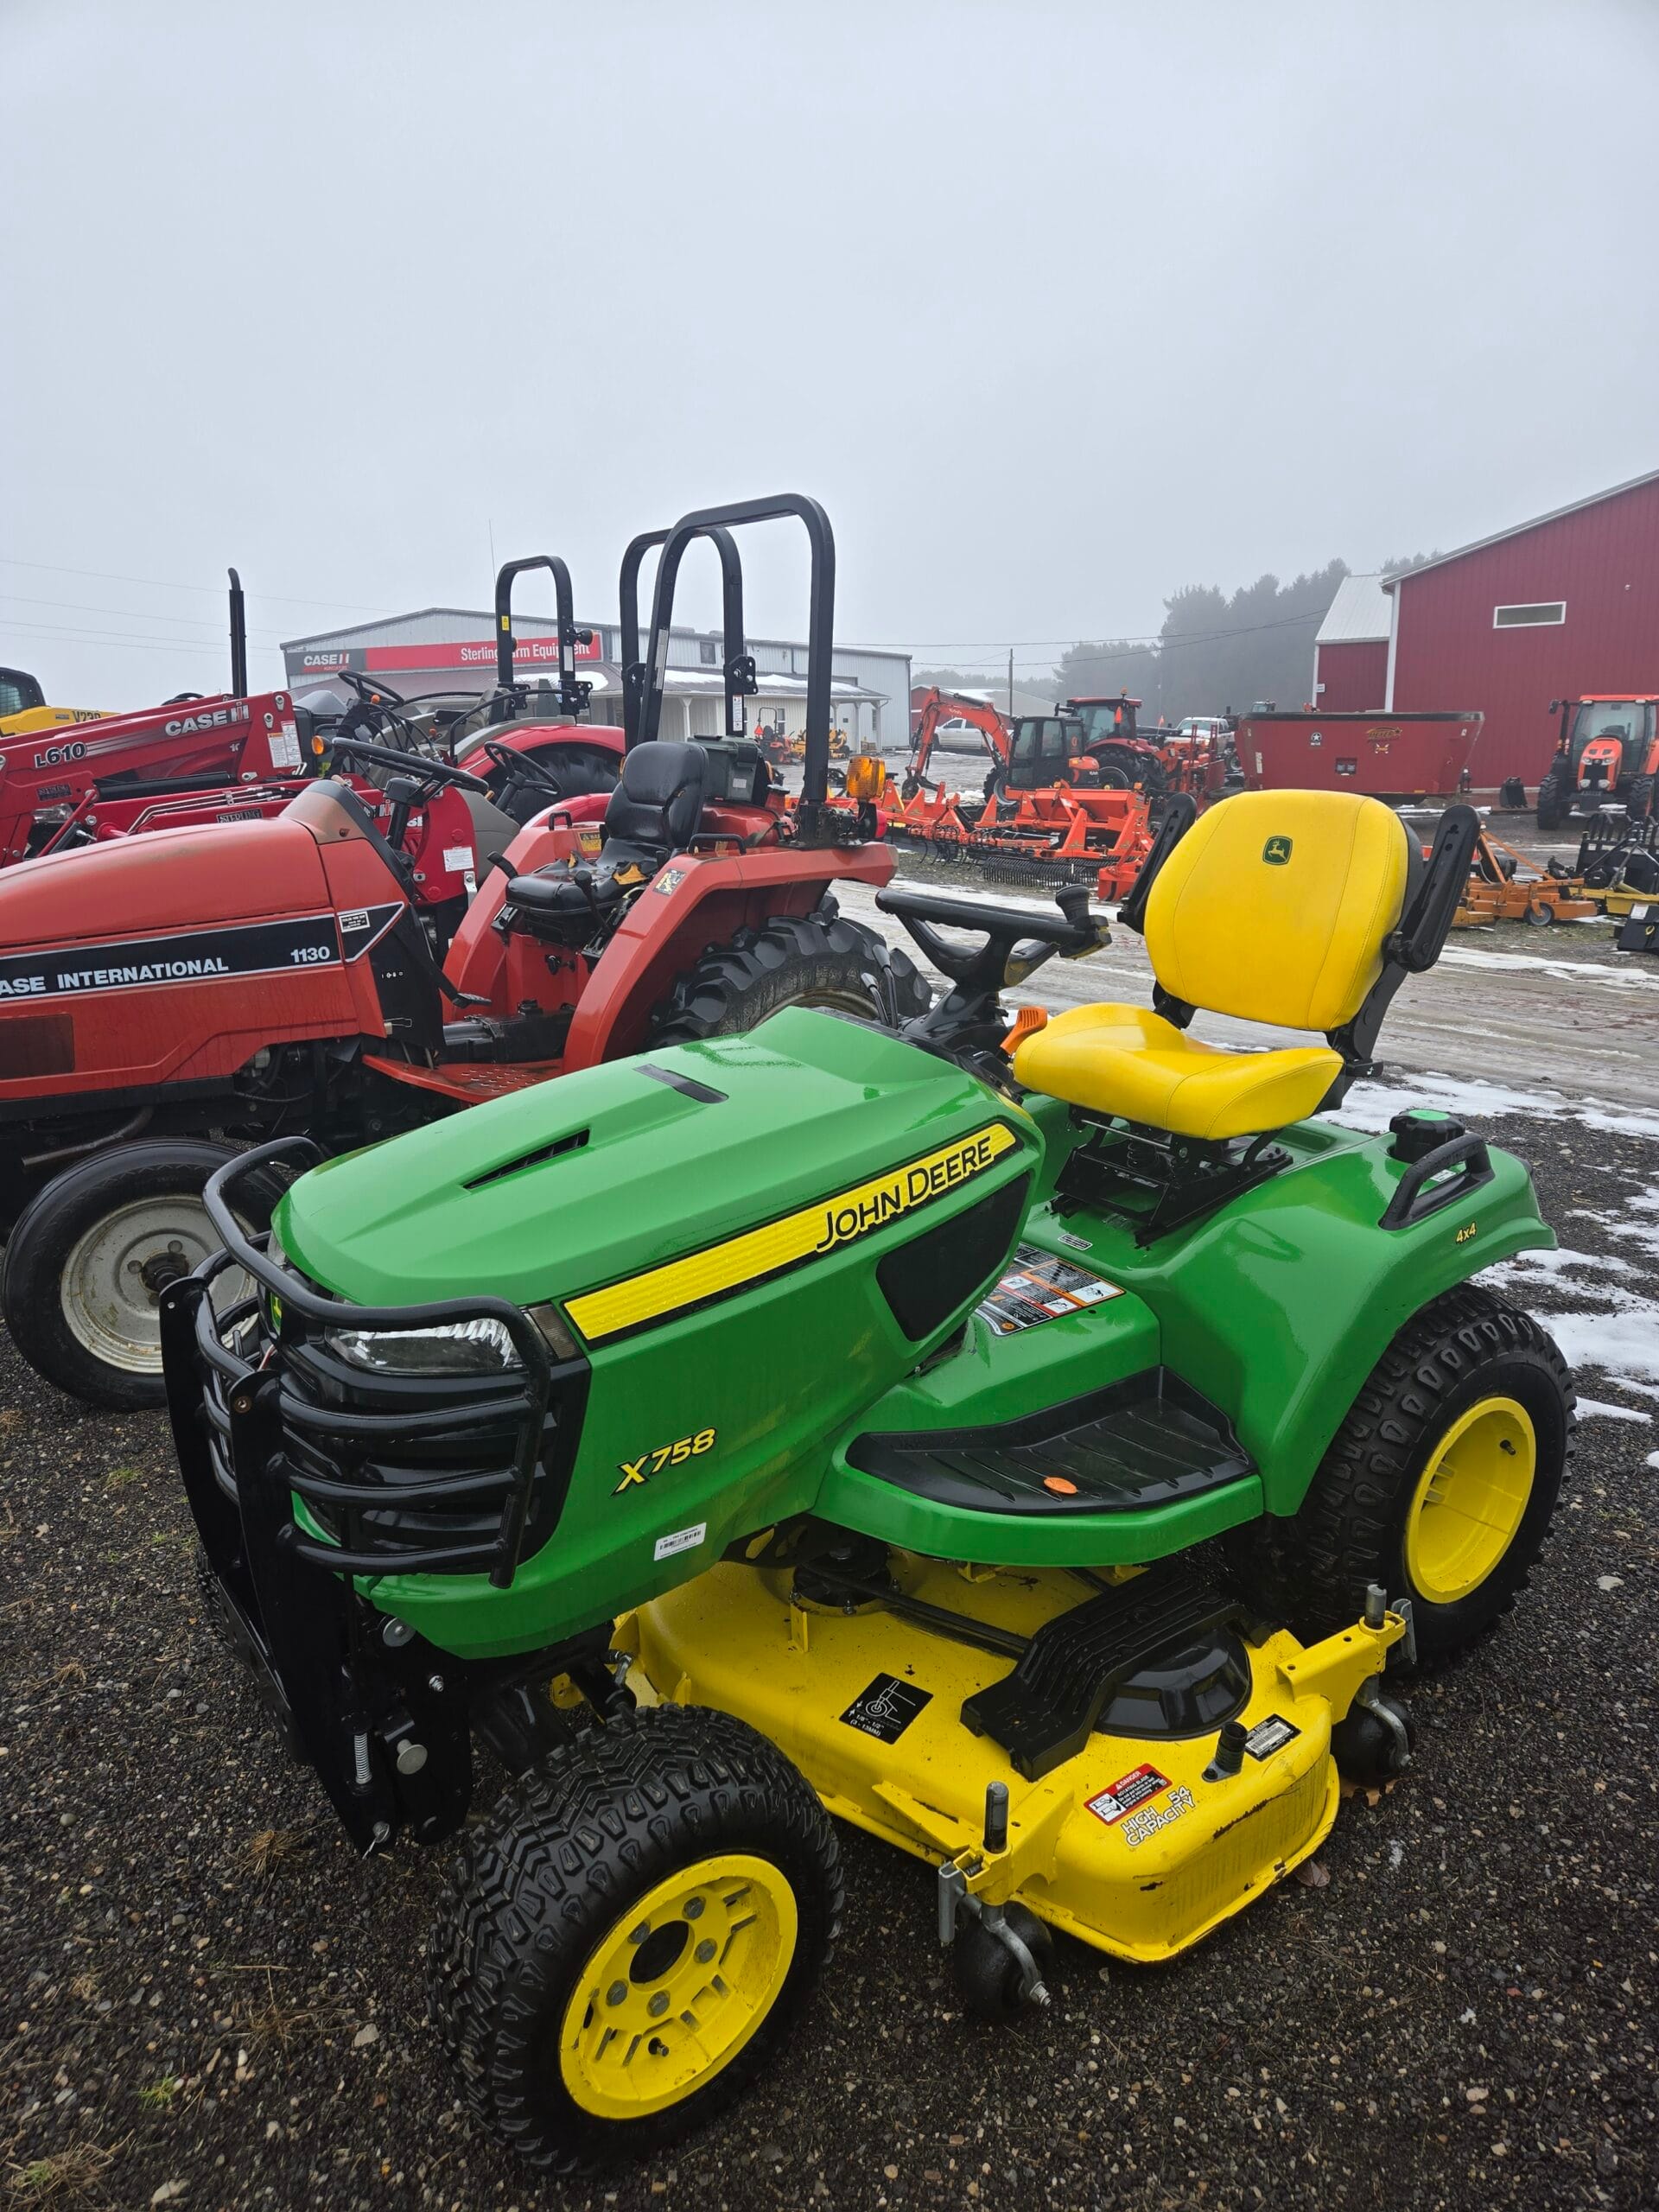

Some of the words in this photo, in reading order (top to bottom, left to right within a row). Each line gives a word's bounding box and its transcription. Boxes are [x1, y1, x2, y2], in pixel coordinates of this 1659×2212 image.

[303, 653, 338, 666] CASE
[165, 709, 228, 736] CASE
[35, 741, 87, 768] L610
[290, 946, 330, 963] 1130
[57, 957, 230, 989] INTERNATIONAL
[816, 1185, 901, 1250] JOHN
[906, 1135, 993, 1204] DEERE
[1455, 1222, 1477, 1244] 4x4
[613, 1427, 716, 1495] X758
[1119, 1770, 1141, 1787] DANGER
[1121, 1806, 1159, 1835] HIGH
[1167, 1785, 1192, 1805] 54
[1126, 1794, 1196, 1847] CAPACITY
